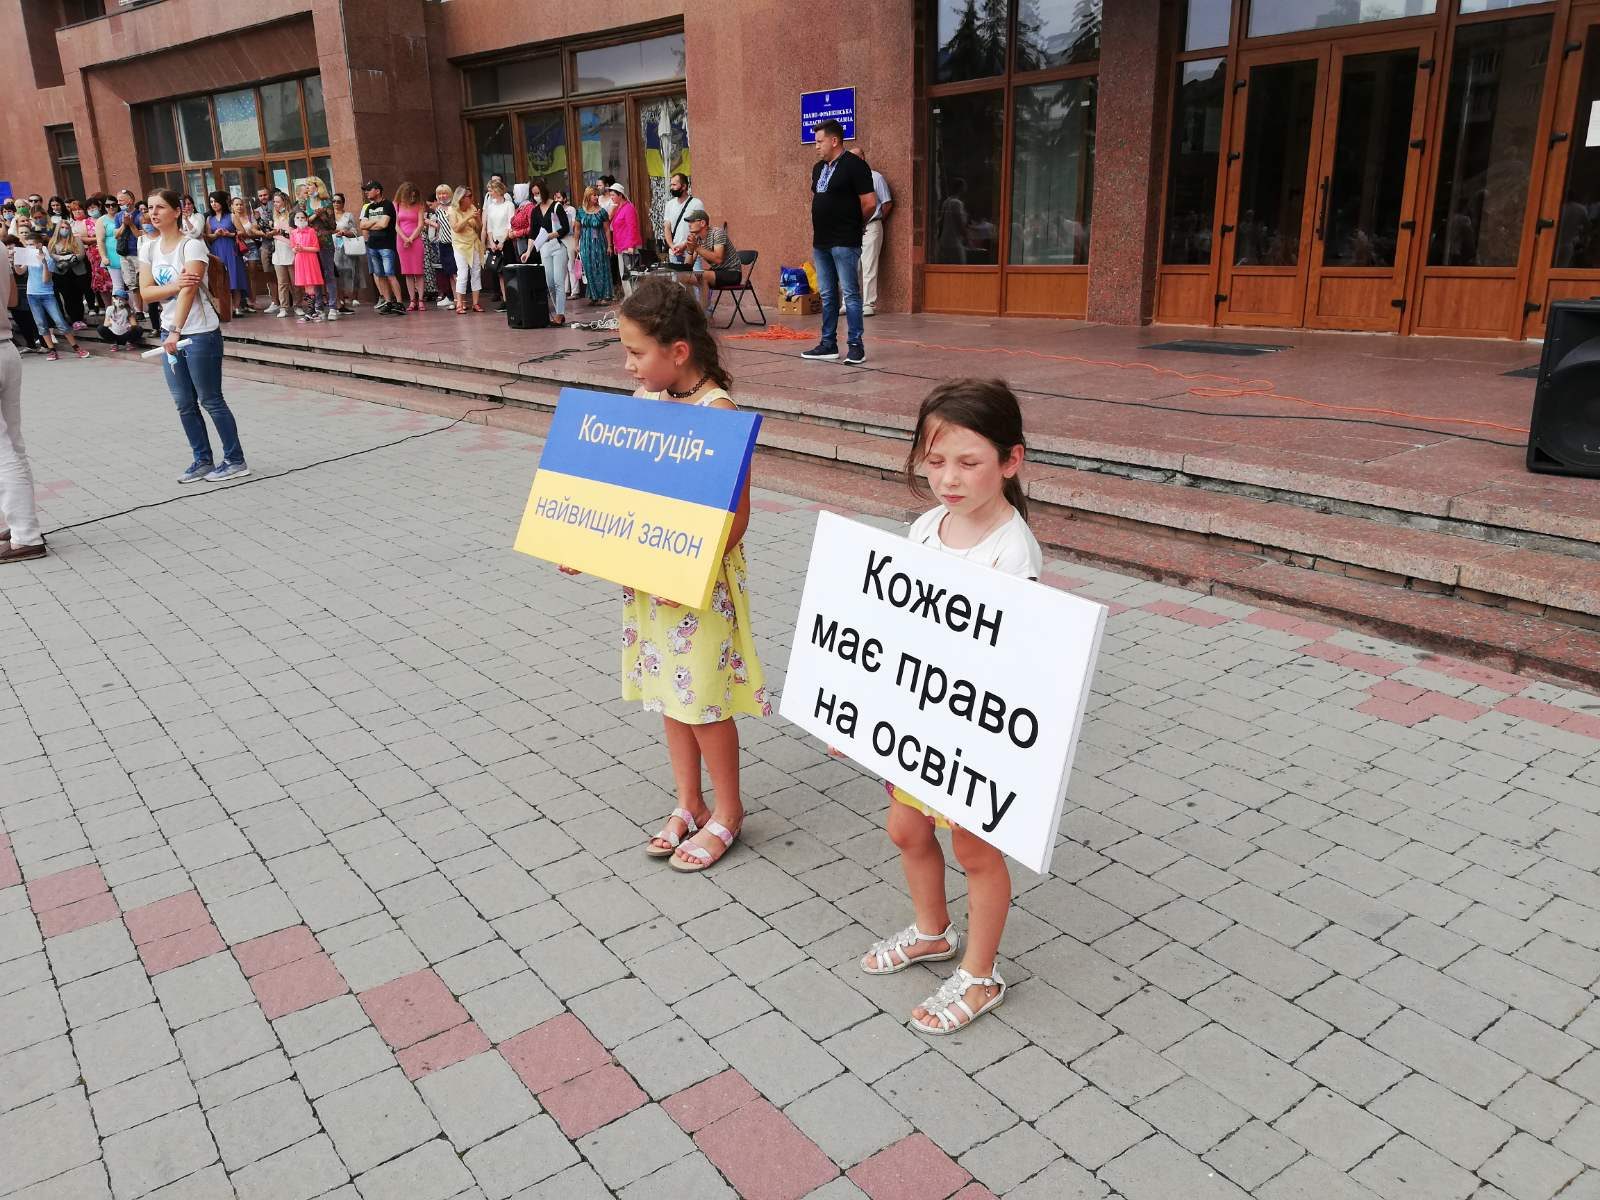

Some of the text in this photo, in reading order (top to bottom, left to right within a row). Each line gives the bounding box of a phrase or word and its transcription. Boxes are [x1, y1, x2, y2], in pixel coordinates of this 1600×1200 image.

[578, 413, 715, 463] Конституція-
[535, 495, 704, 559] найвищий закон
[863, 550, 1003, 648] Кожен
[811, 613, 1039, 749] має право
[813, 687, 1017, 833] на освіту
